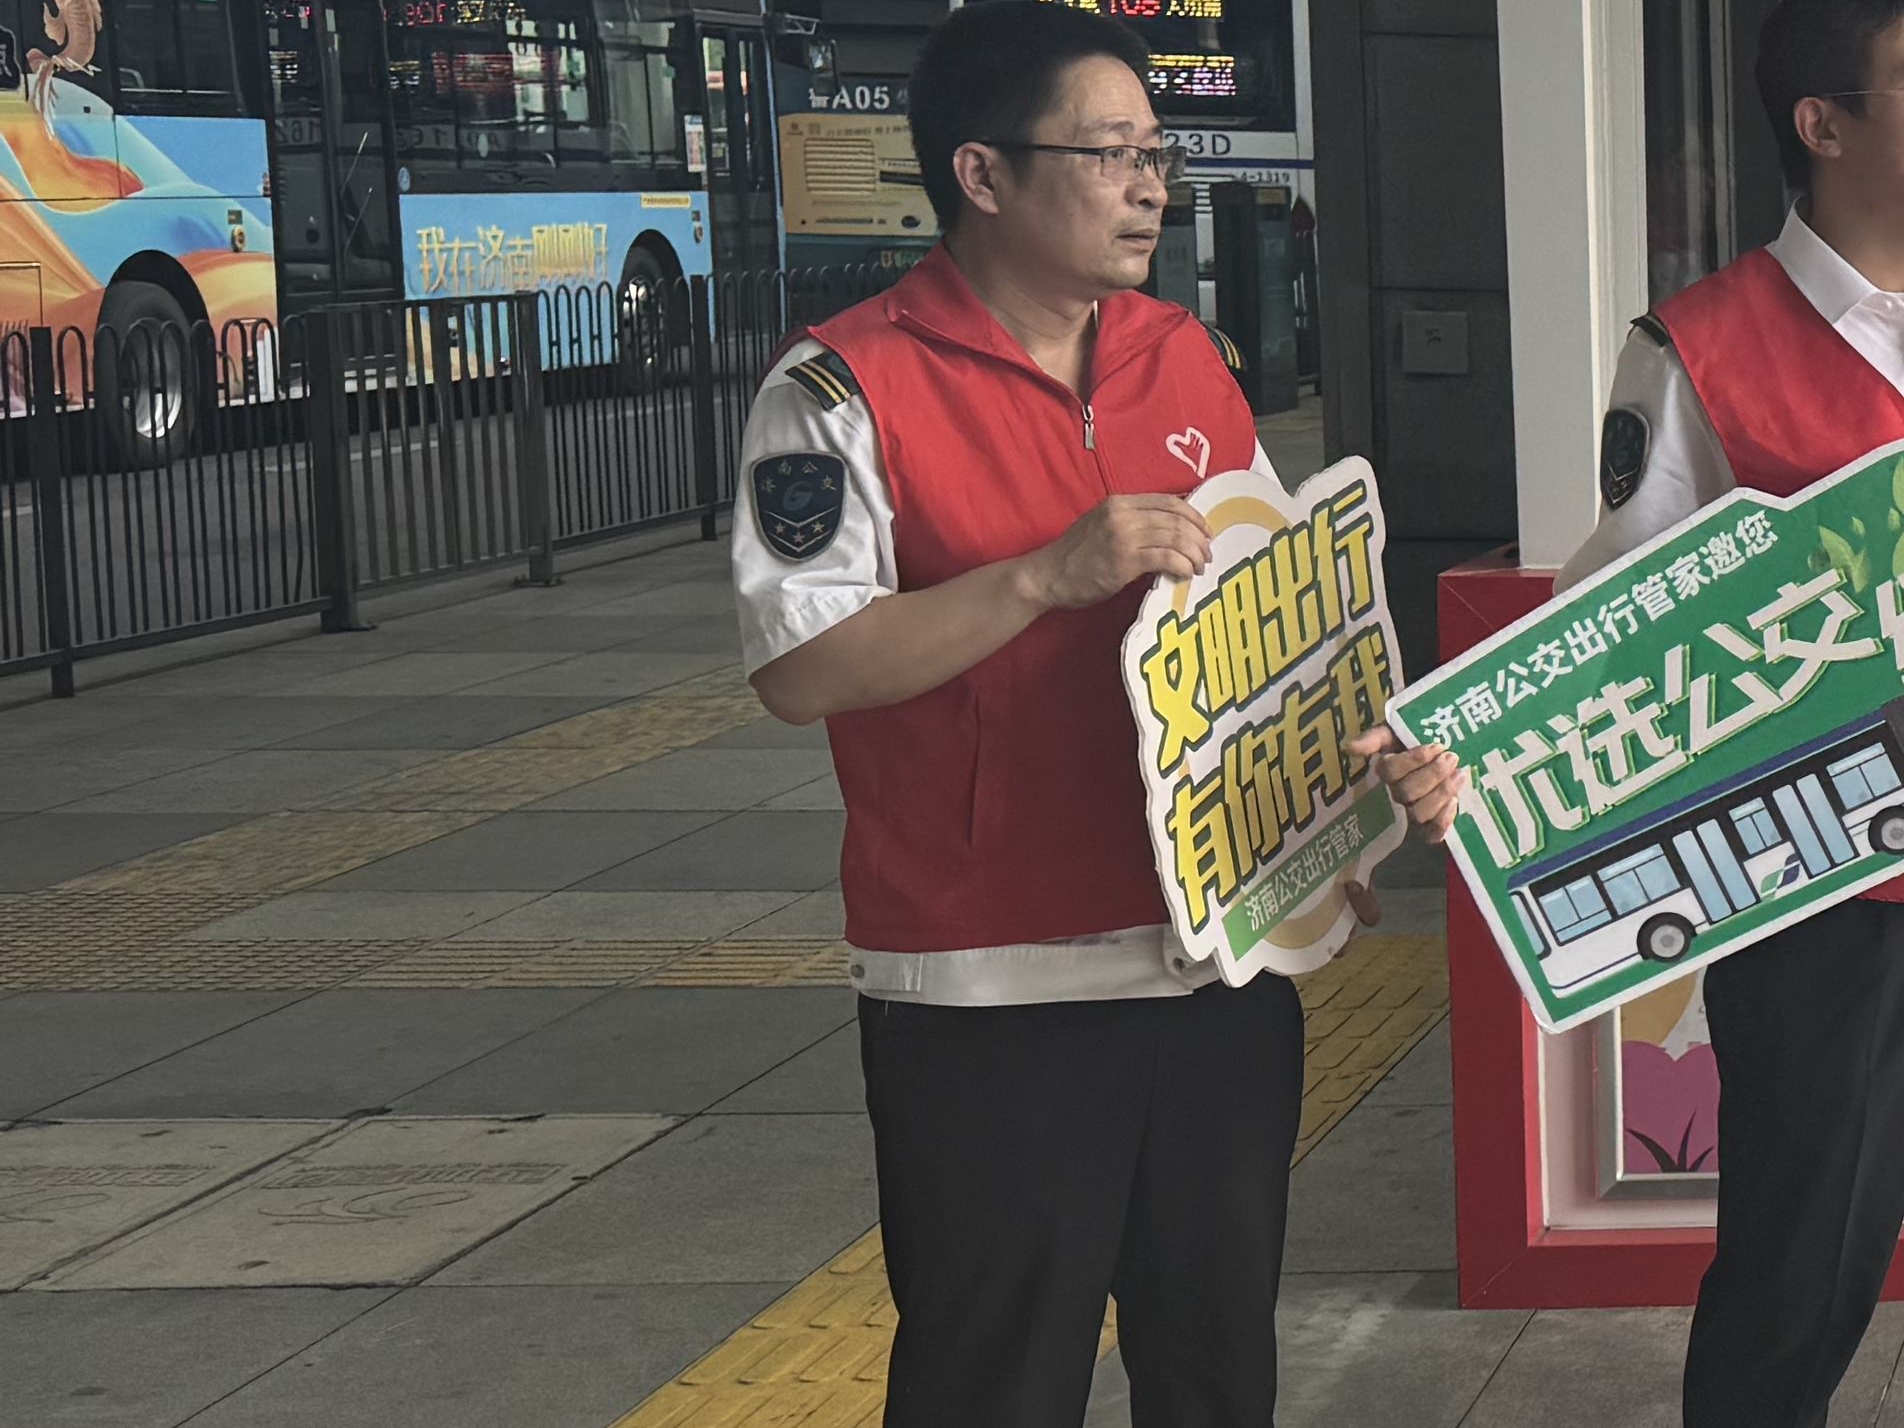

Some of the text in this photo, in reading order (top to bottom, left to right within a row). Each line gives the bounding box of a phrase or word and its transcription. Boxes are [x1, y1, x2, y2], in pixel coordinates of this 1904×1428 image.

[1142, 479, 1375, 772] 文明出行
[1420, 509, 1779, 748] 济南公交出行管家邀您
[1457, 568, 1884, 870] 优选公交
[1167, 626, 1390, 934] 有你有我
[1246, 813, 1364, 932] 济南公交出行管家
